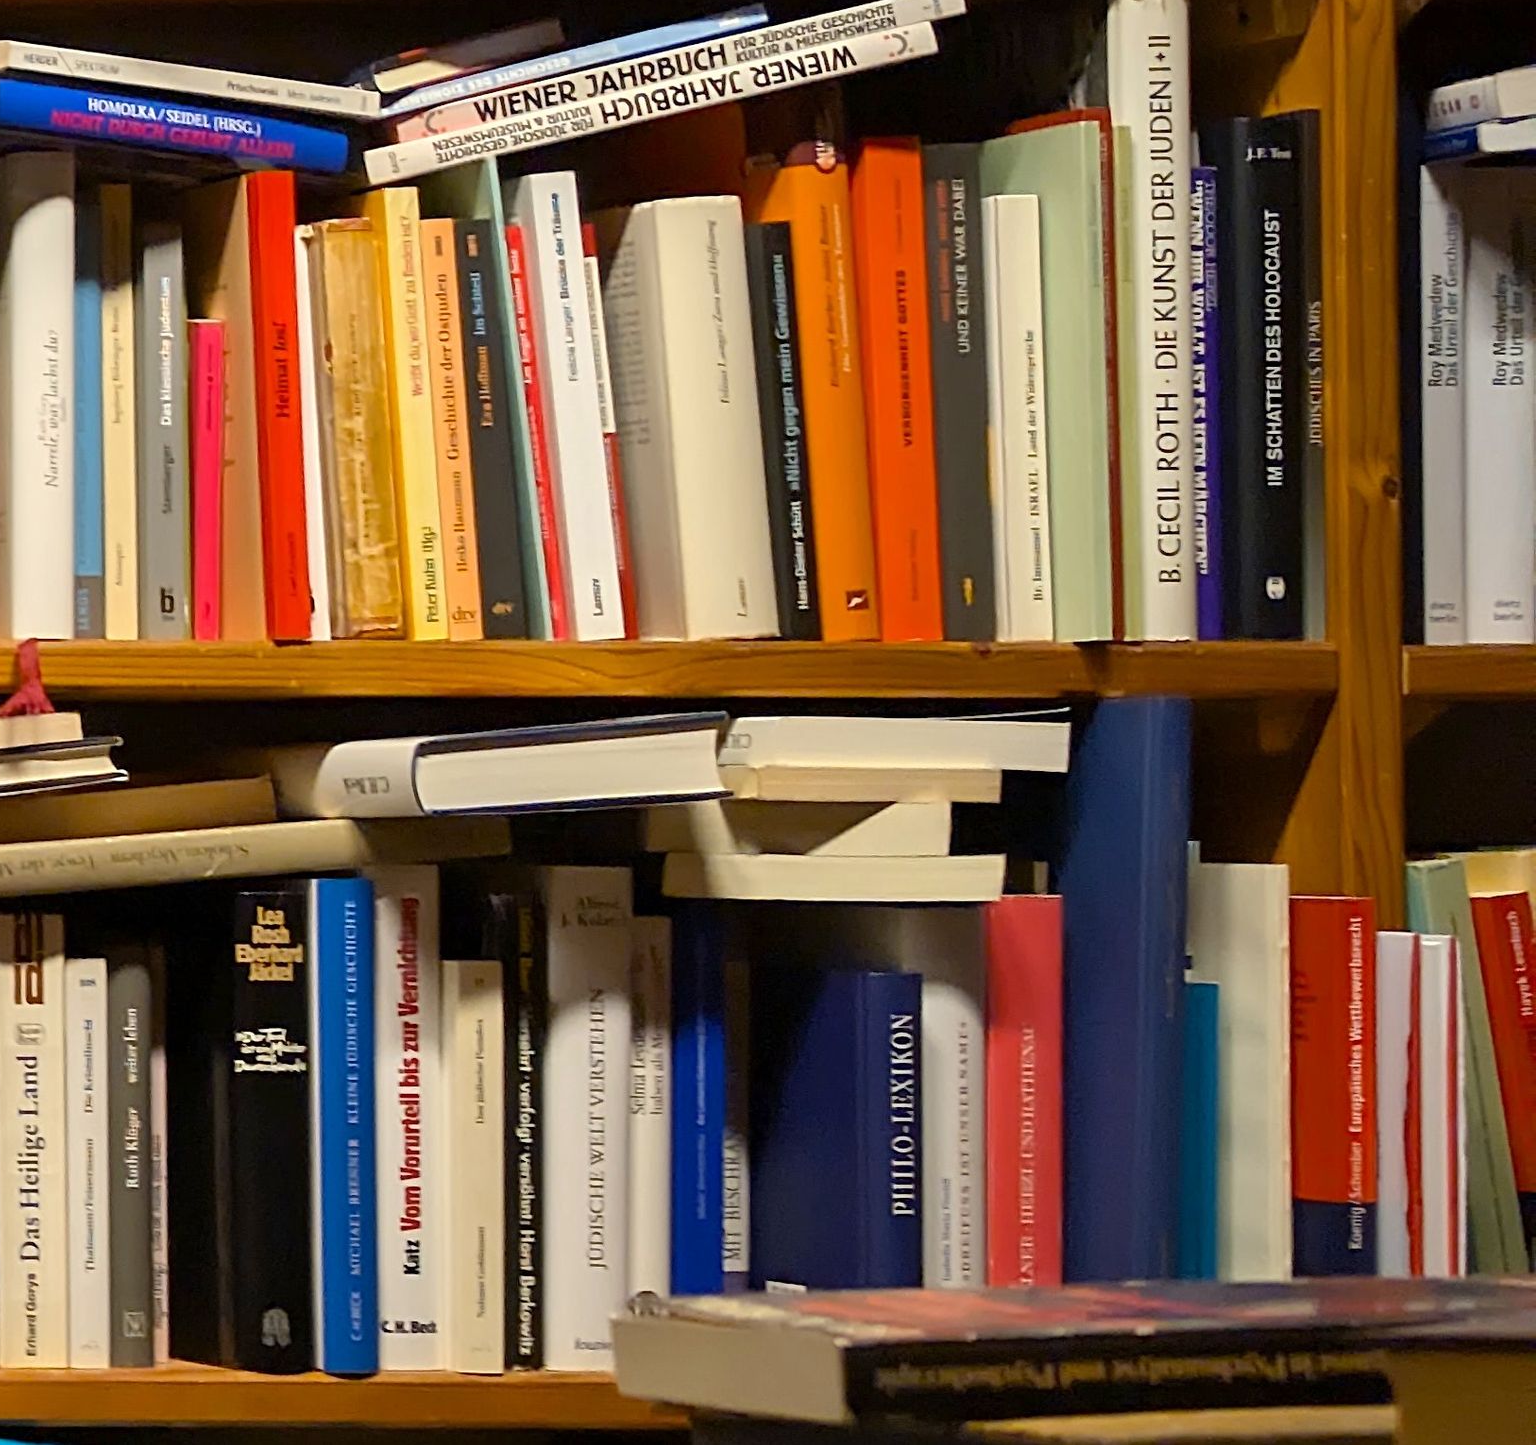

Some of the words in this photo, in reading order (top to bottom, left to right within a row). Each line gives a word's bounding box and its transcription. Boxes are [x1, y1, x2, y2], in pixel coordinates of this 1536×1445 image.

[473, 77, 580, 125] WIENER
[584, 42, 730, 105] JAHRBUCH
[599, 75, 746, 126] JAHRBUCH
[752, 44, 858, 88] WIENER
[1149, 78, 1174, 164] JUDEN
[1151, 171, 1176, 221] DER
[1153, 230, 1178, 323] KUNST
[1263, 209, 1284, 321] HOLOCAUST
[1155, 329, 1178, 370] DIE
[1264, 324, 1284, 361] DES
[1426, 273, 1444, 357] Medwedew
[1427, 359, 1446, 388] Roy
[1155, 393, 1180, 471] ROTH
[1265, 365, 1285, 462] SCHATTEN
[1265, 466, 1285, 487] IM
[1157, 479, 1182, 557] CECIL
[1159, 562, 1182, 584] B.
[14, 1055, 42, 1117] Land
[888, 1013, 917, 1217] PHILO-LEXIKON
[15, 1123, 44, 1210] Heilige
[16, 1215, 43, 1263] Das
